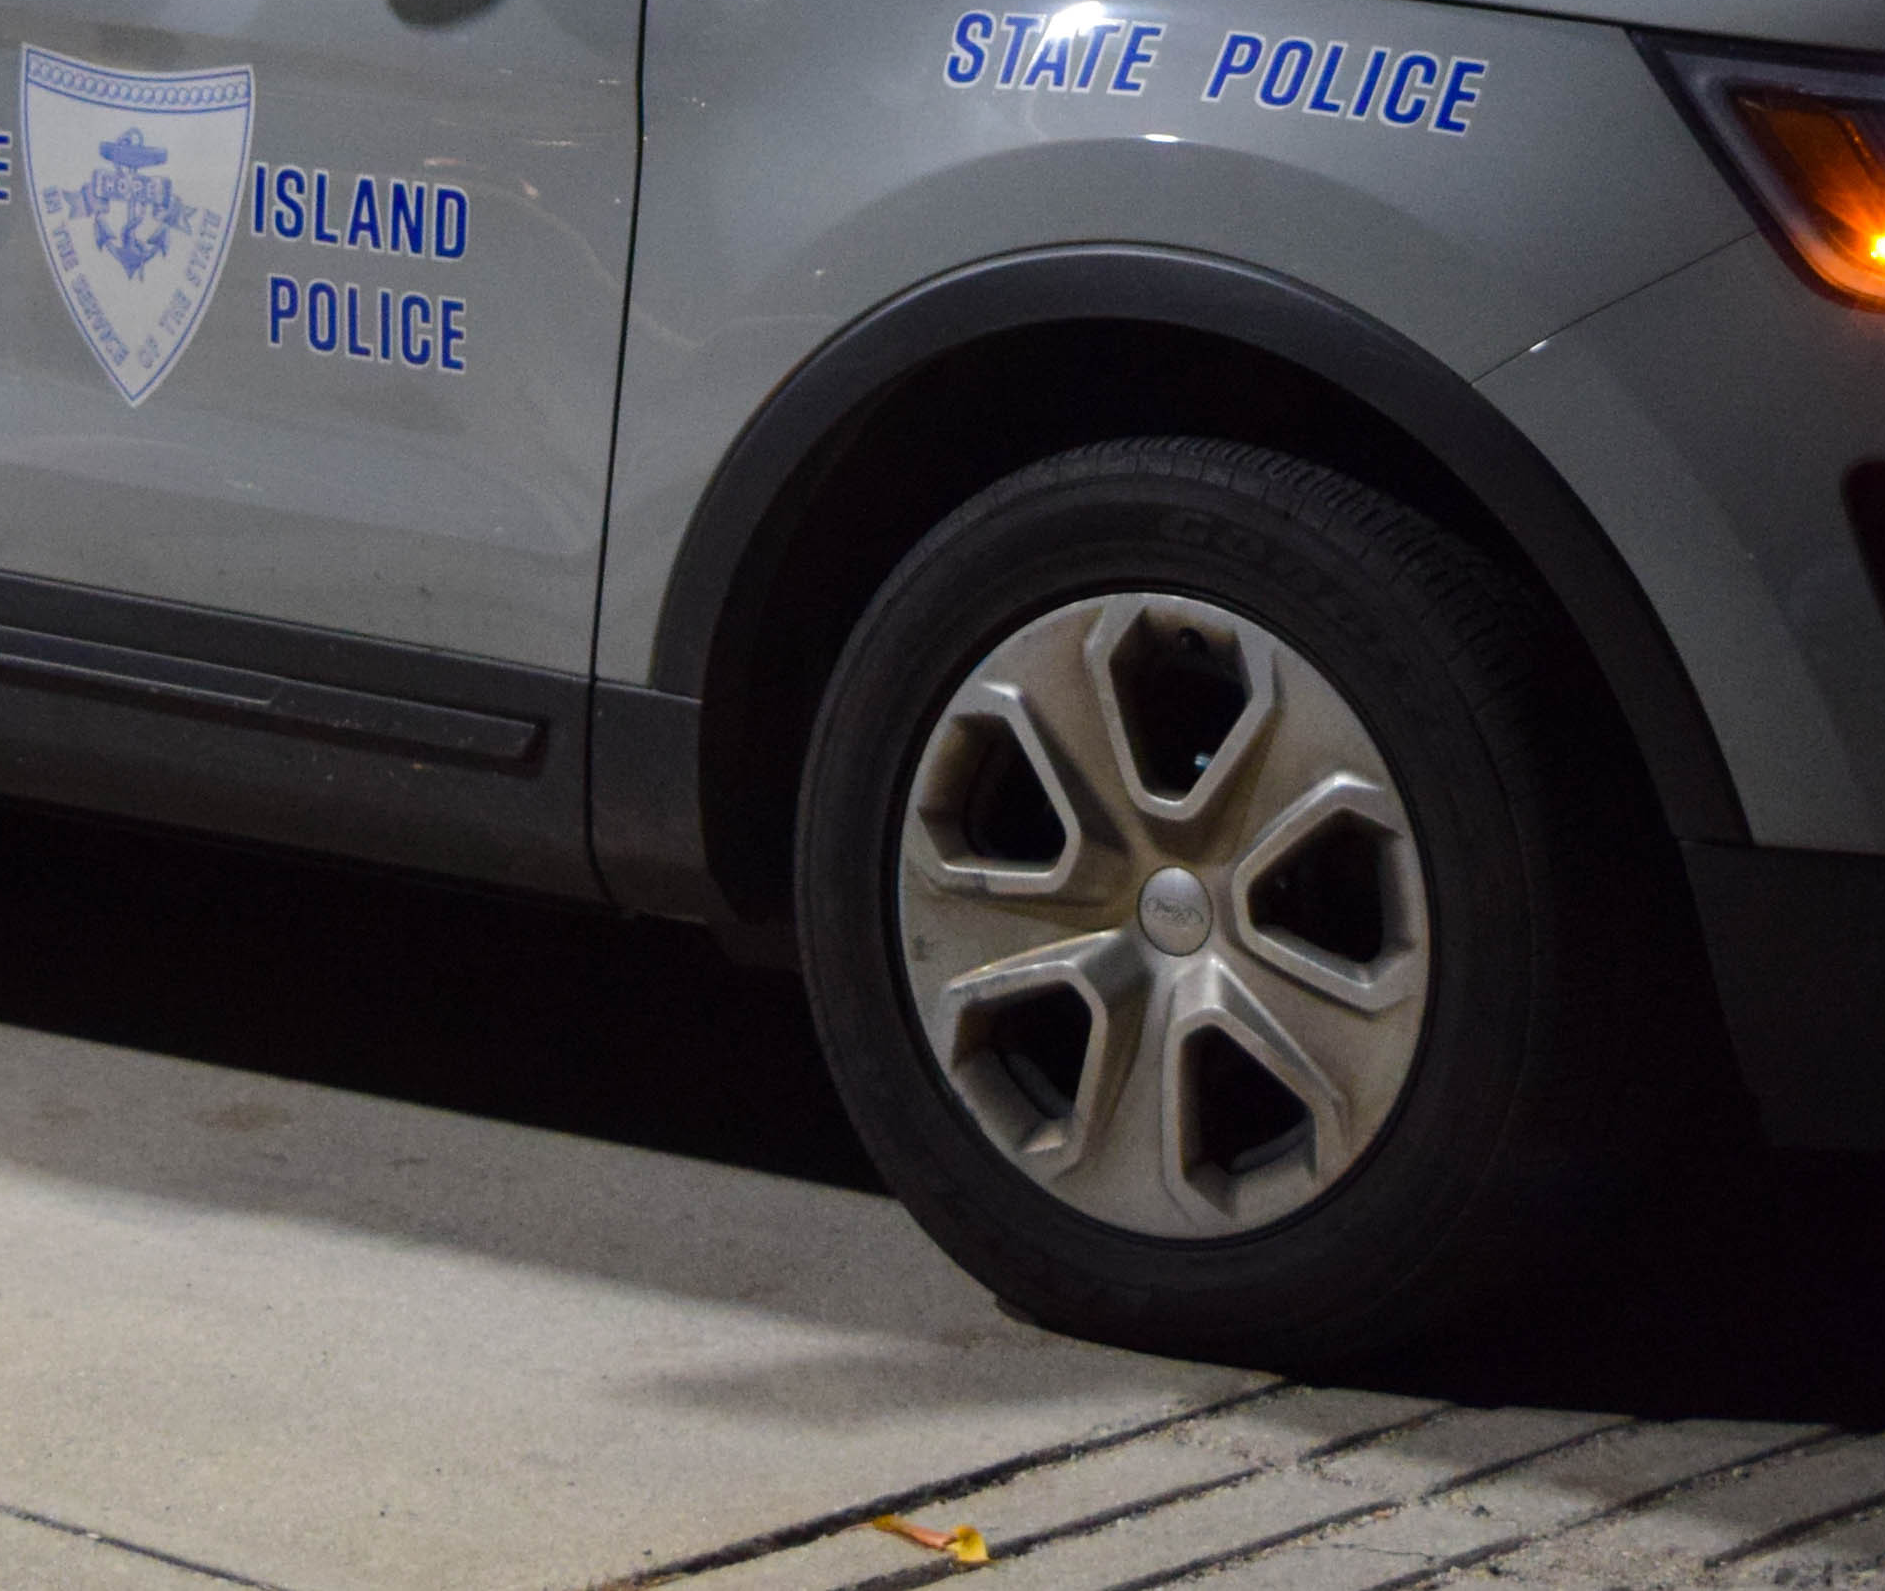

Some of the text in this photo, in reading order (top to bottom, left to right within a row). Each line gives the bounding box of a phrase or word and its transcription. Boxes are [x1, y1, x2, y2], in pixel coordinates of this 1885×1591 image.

[945, 12, 1488, 134] STATE POLICE
[105, 175, 156, 199] HOPE
[252, 163, 469, 260] ISLAND
[53, 223, 79, 272] THE
[138, 334, 160, 369] OF
[159, 288, 192, 335] THE
[185, 209, 222, 287] STATE
[267, 275, 466, 372] POLICE
